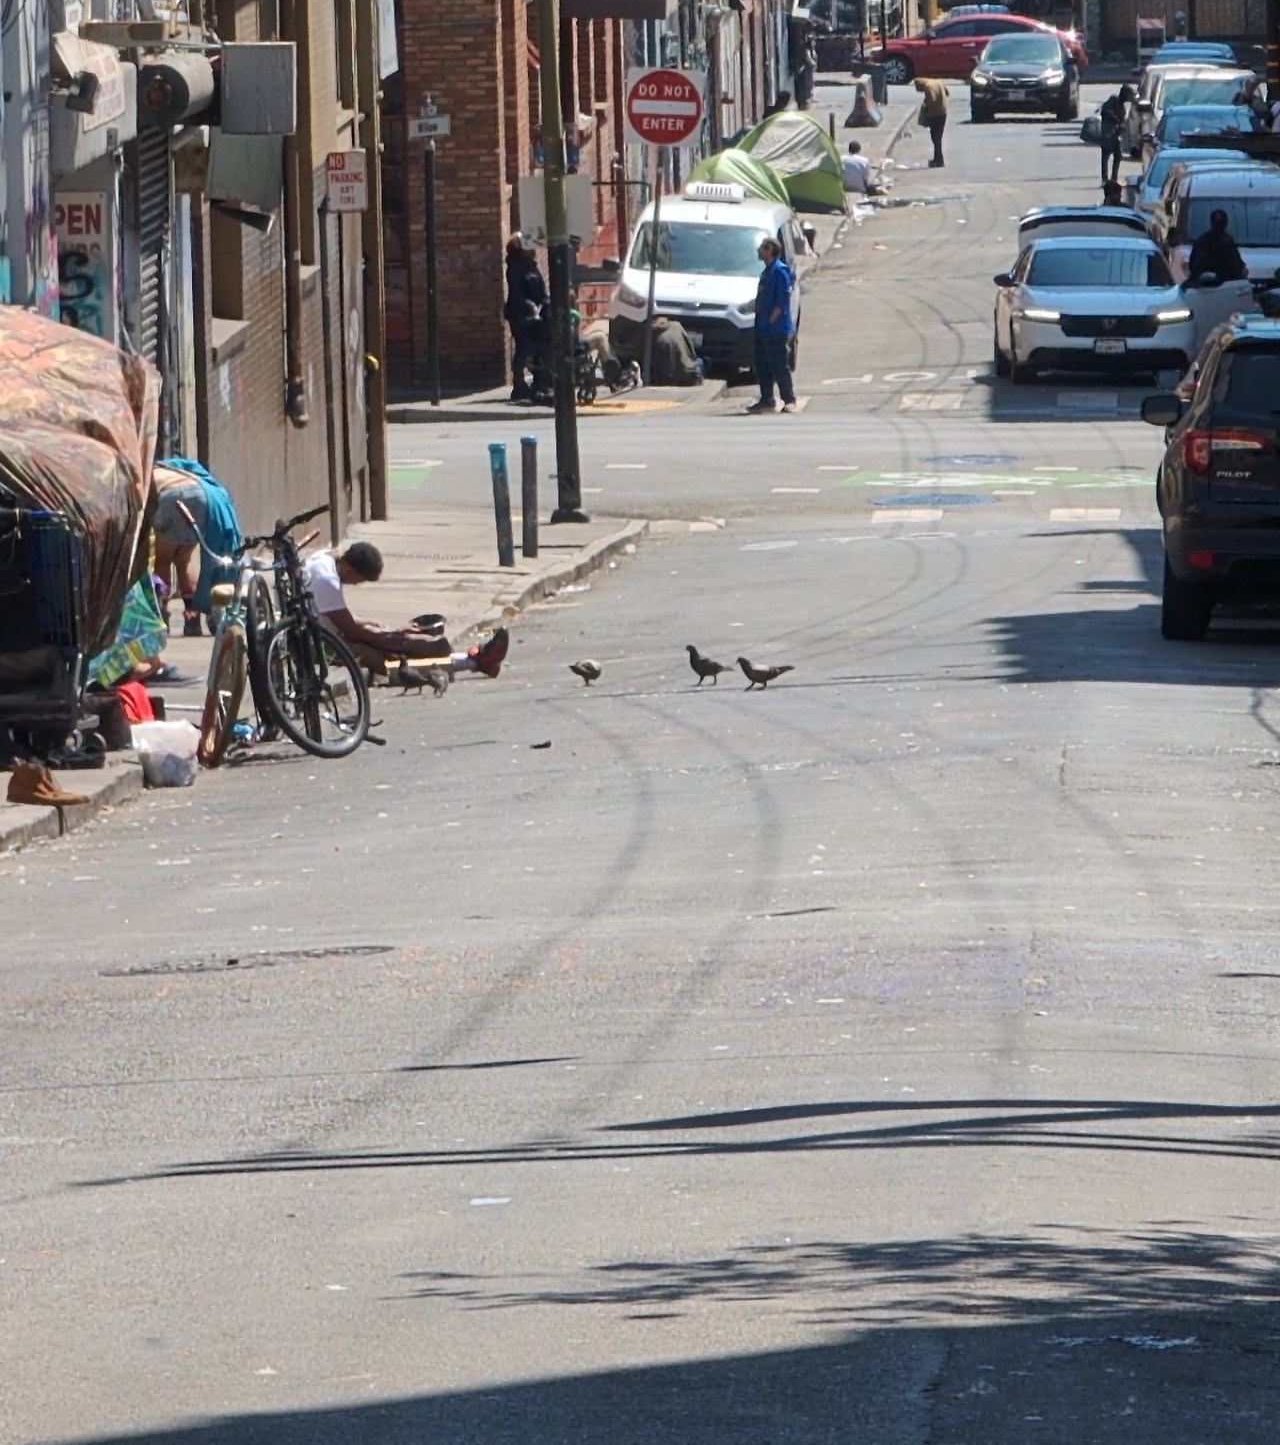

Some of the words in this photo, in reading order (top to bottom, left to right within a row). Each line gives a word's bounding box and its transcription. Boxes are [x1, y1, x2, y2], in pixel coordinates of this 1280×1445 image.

[638, 83, 658, 97] DO
[663, 84, 691, 98] NOT
[642, 117, 685, 131] ENTER
[328, 154, 343, 168] NO
[330, 171, 364, 185] PARKING
[1216, 470, 1252, 478] PILOT
